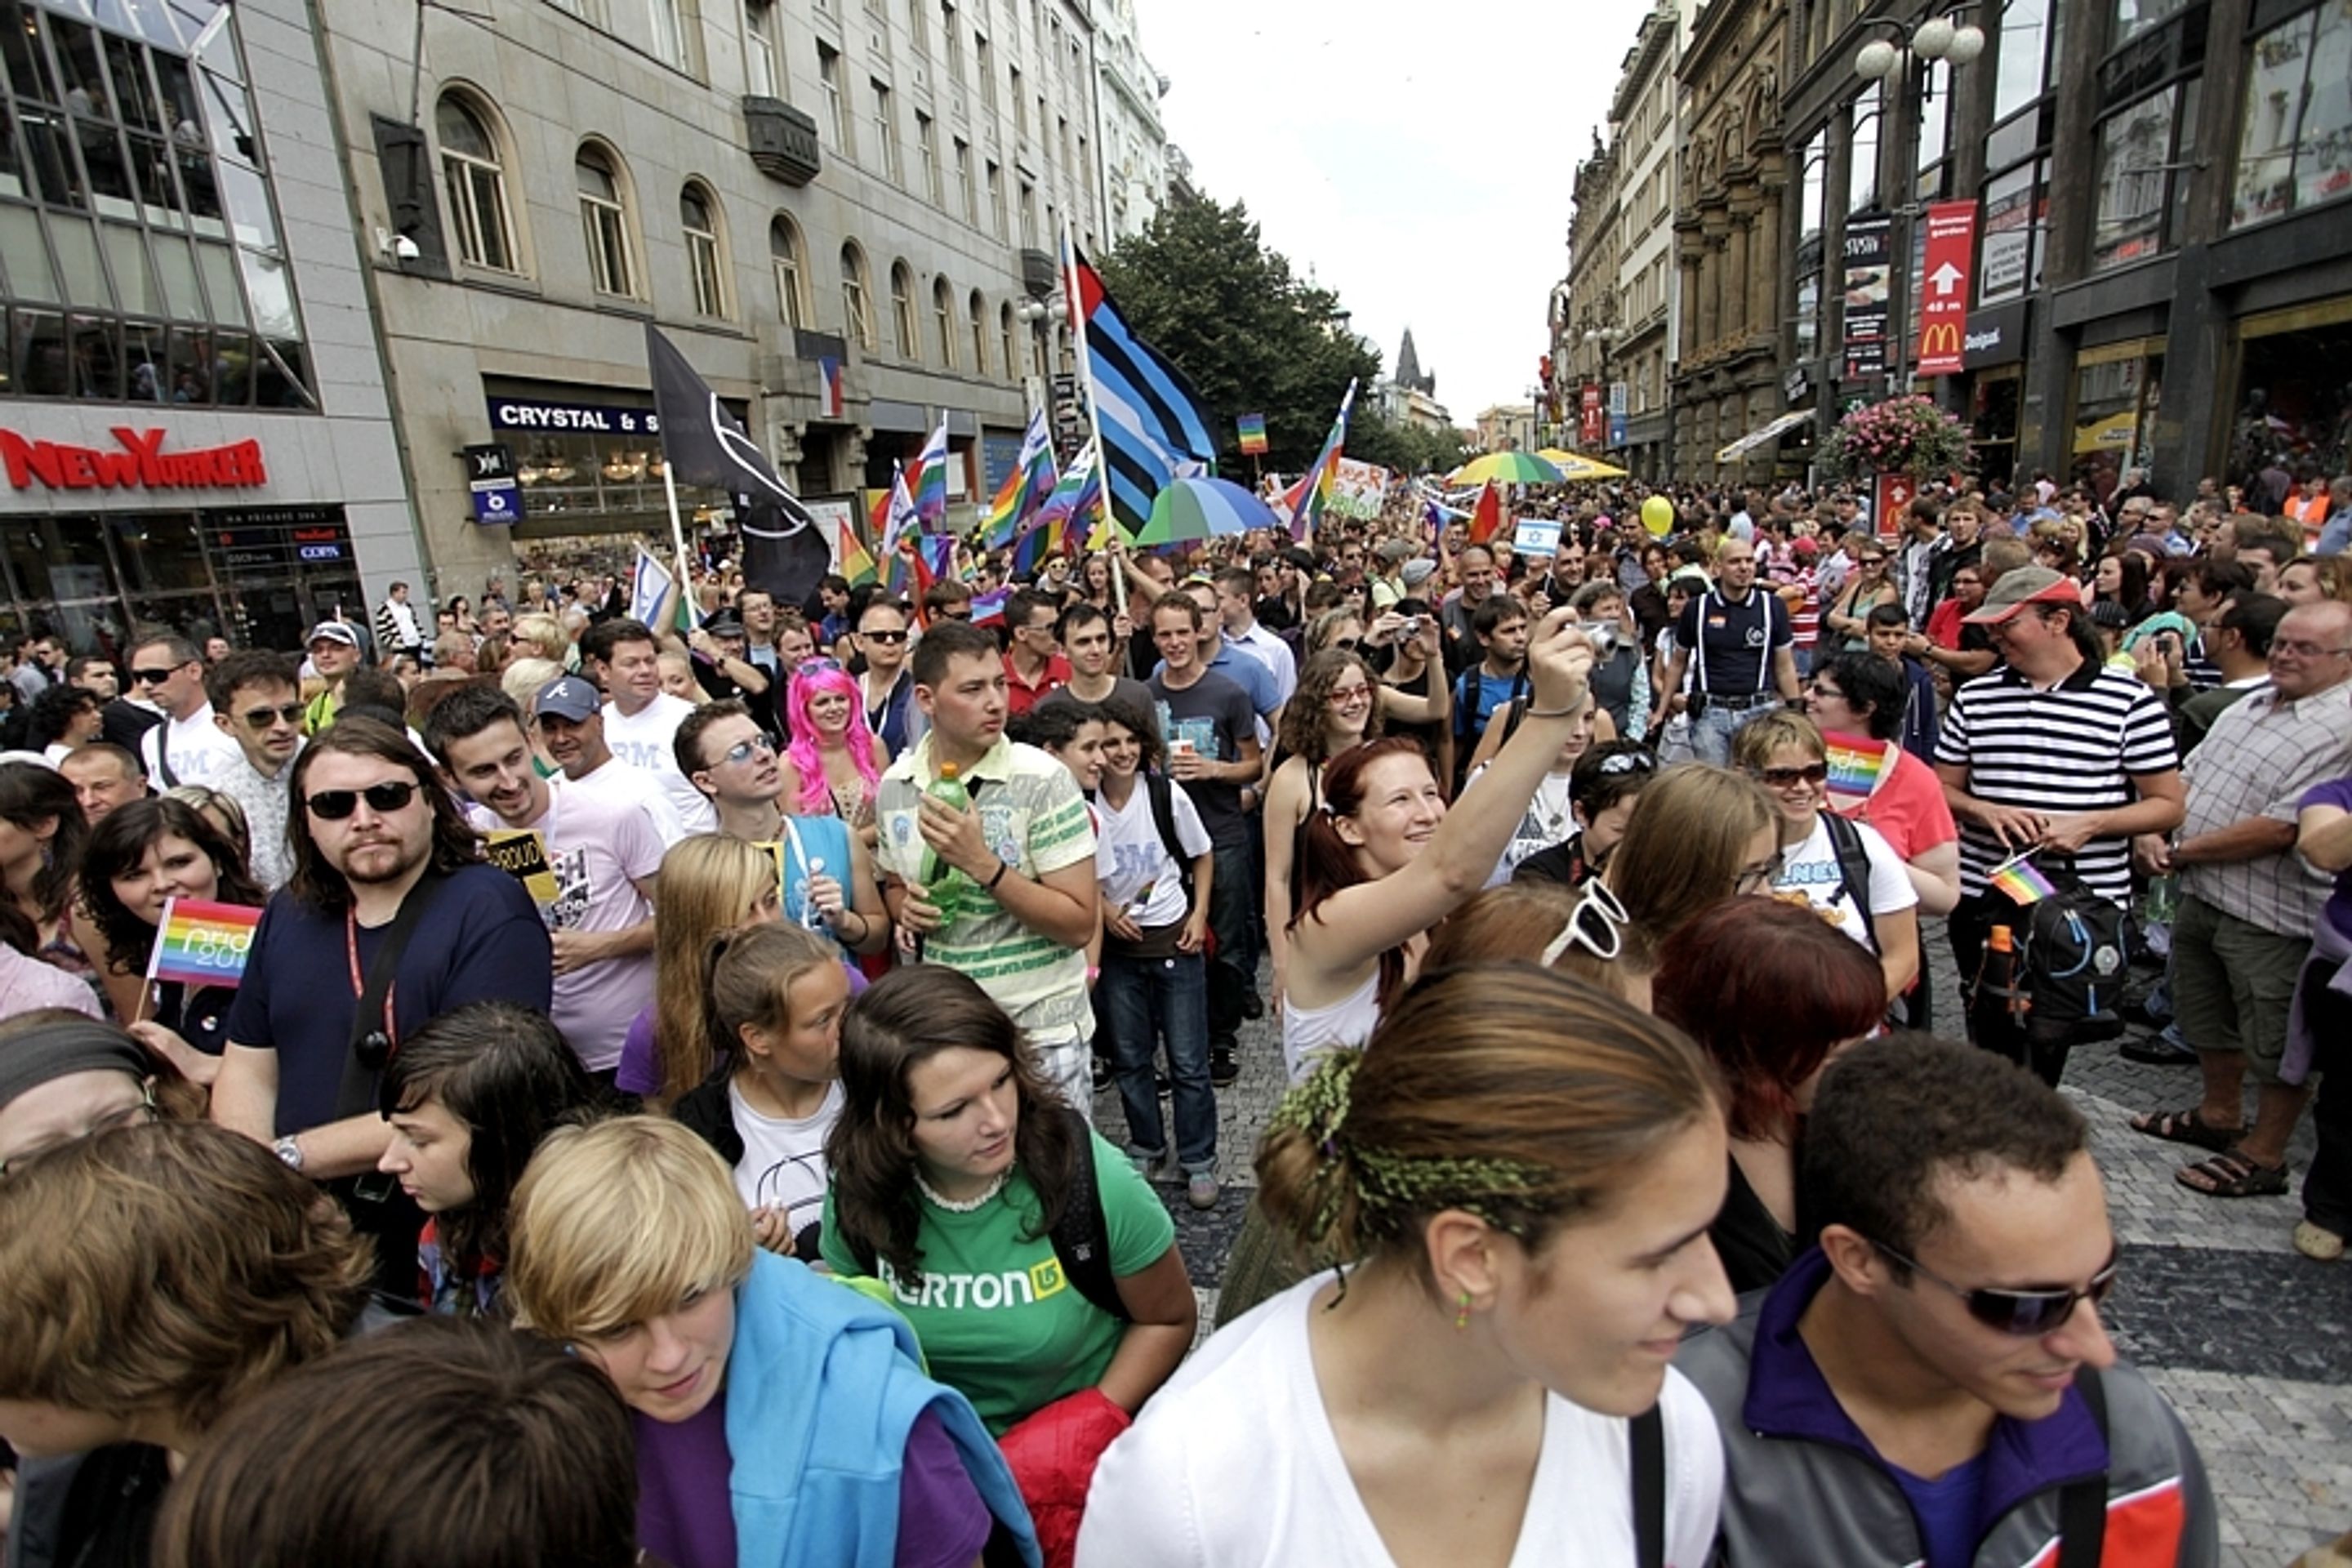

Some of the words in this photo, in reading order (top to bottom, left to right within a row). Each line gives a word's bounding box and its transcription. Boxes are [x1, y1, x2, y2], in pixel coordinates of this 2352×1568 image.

[500, 405, 610, 430] CRYSTAL
[620, 412, 635, 431] &
[182, 925, 256, 954] prid
[195, 943, 247, 969] 201
